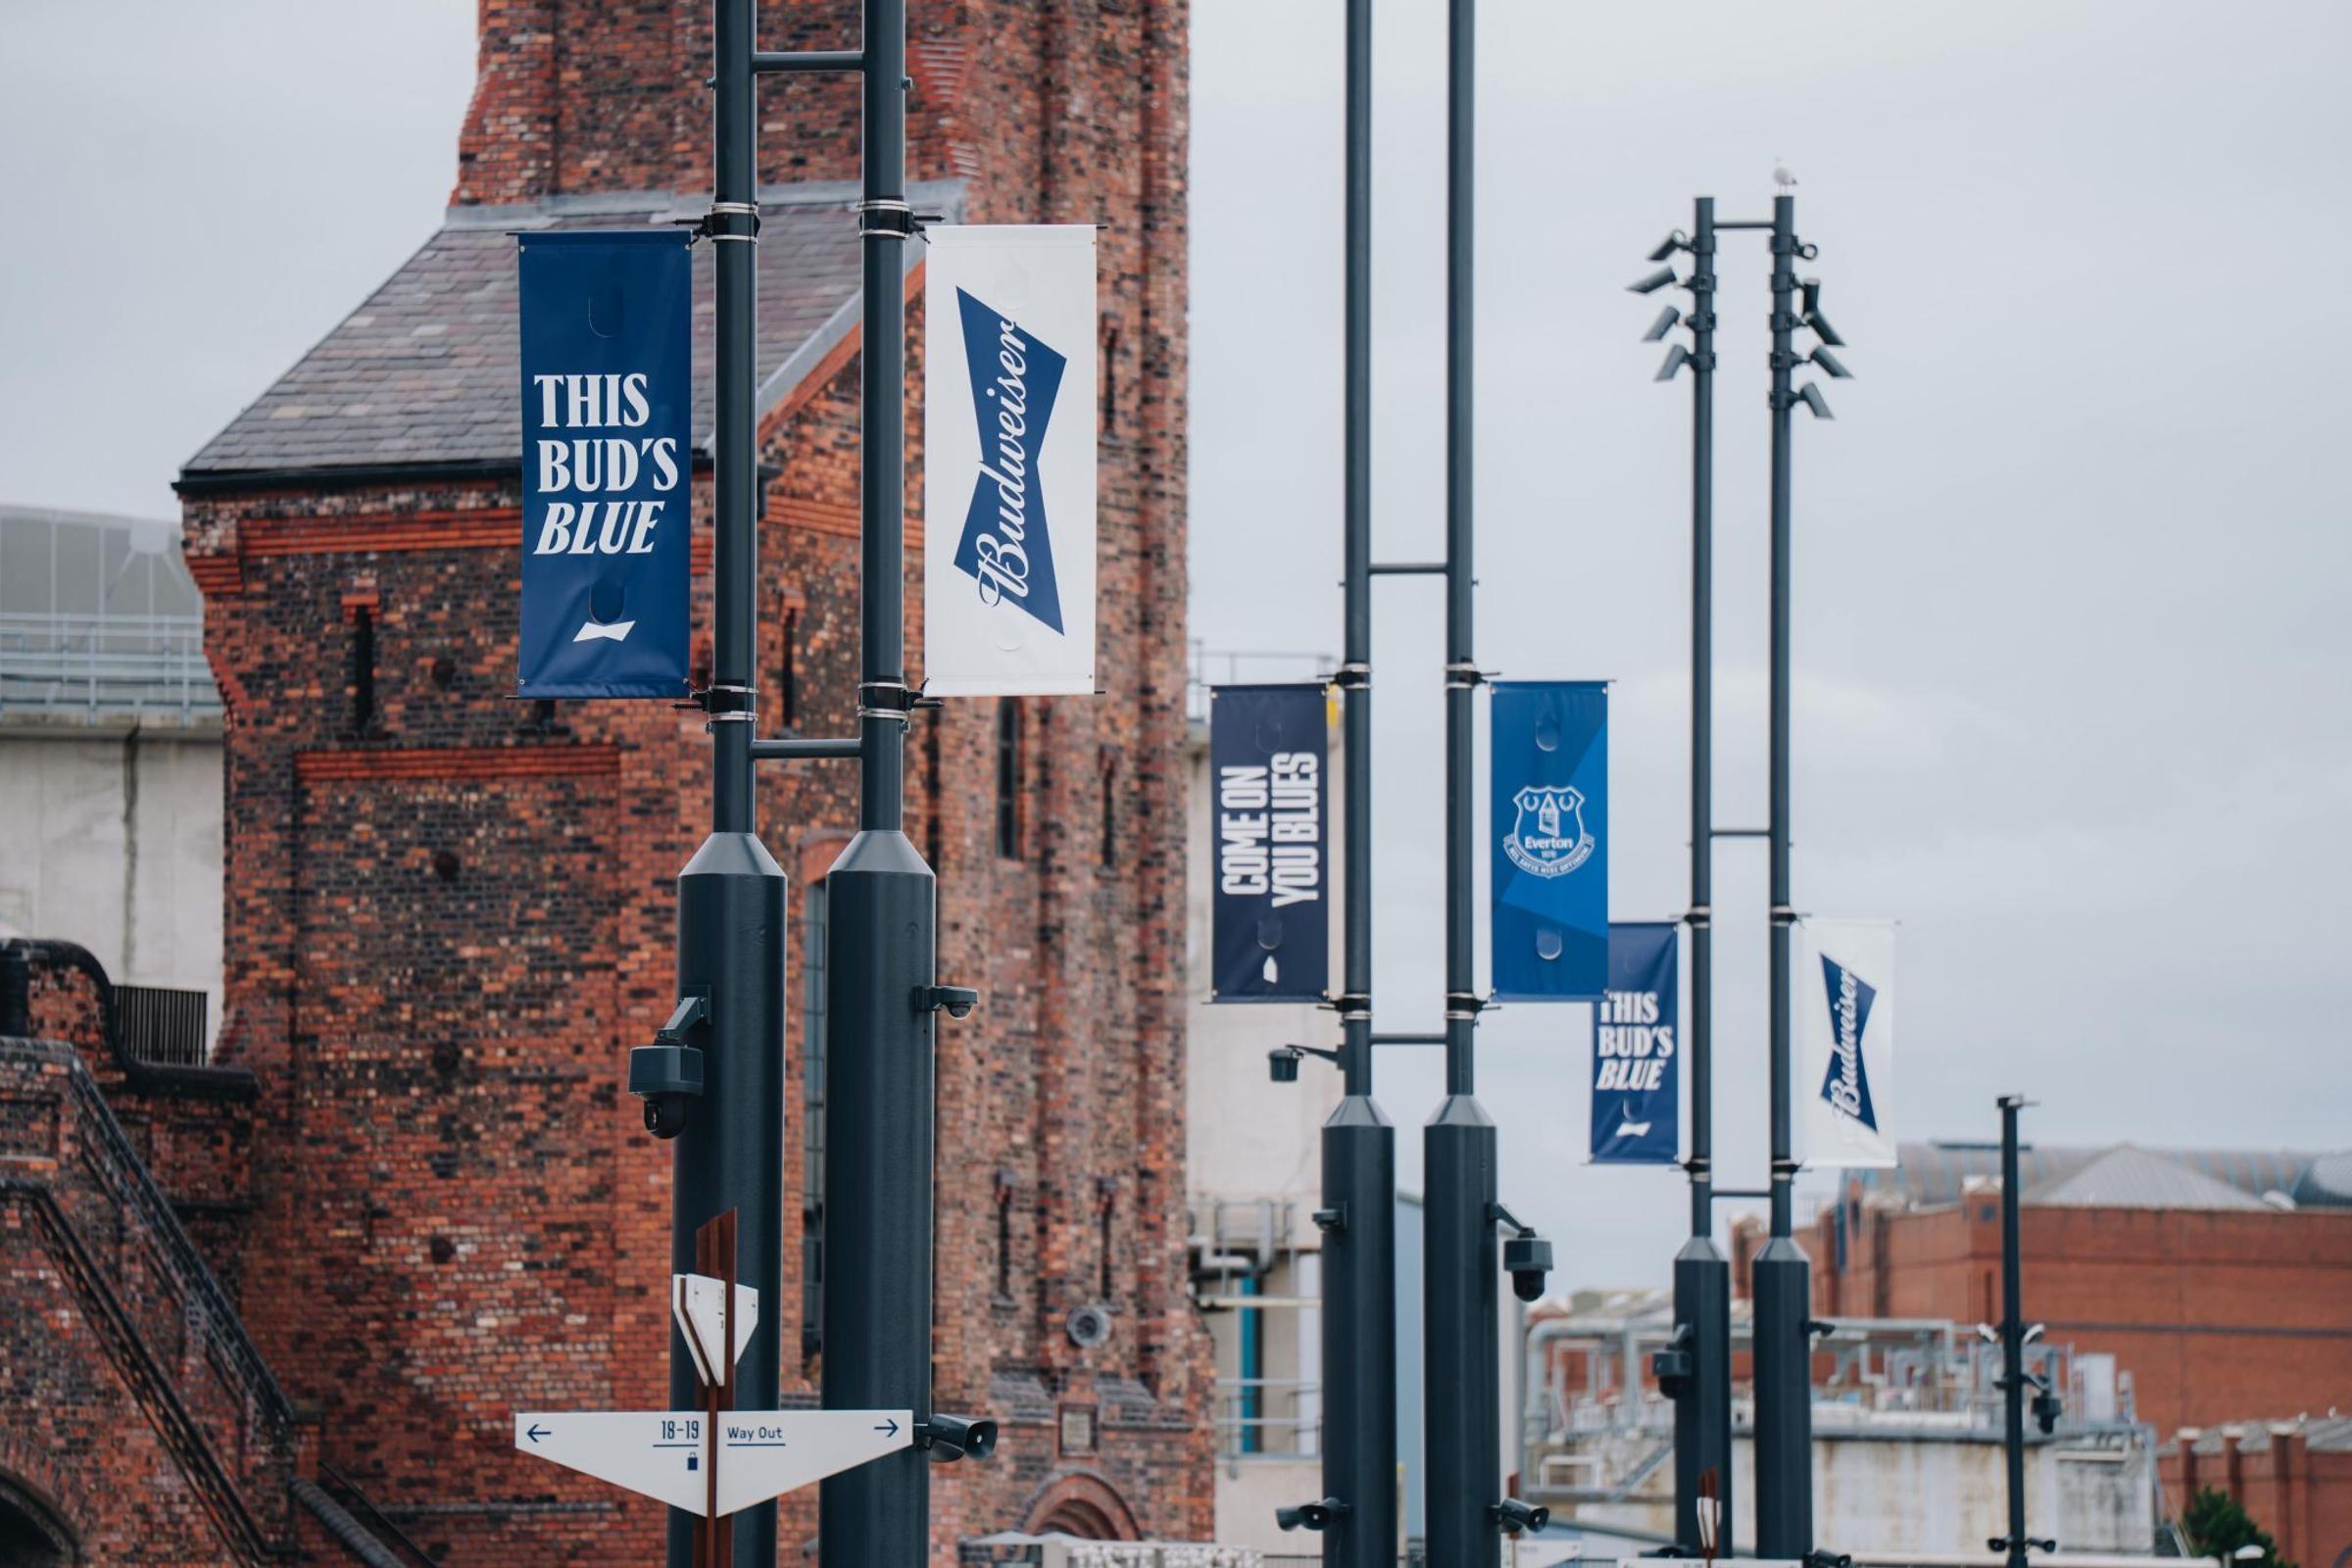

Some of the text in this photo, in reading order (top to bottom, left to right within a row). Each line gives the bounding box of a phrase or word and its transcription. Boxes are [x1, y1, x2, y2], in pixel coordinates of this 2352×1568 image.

[533, 372, 651, 428] THIS
[536, 437, 679, 493] BUD'S
[976, 318, 1029, 608] Budweiser
[532, 501, 666, 556] BLUE
[1221, 765, 1269, 895] COME ON
[1271, 752, 1319, 907] YOU BLUES
[1524, 835, 1574, 850] Everton
[1599, 990, 1659, 1024] THIS
[1597, 1025, 1674, 1058] BUD'S
[1830, 967, 1861, 1120] Budweiser
[1595, 1058, 1667, 1091] BLUE
[662, 1420, 699, 1440] 18-19
[727, 1427, 782, 1442] Way Out
